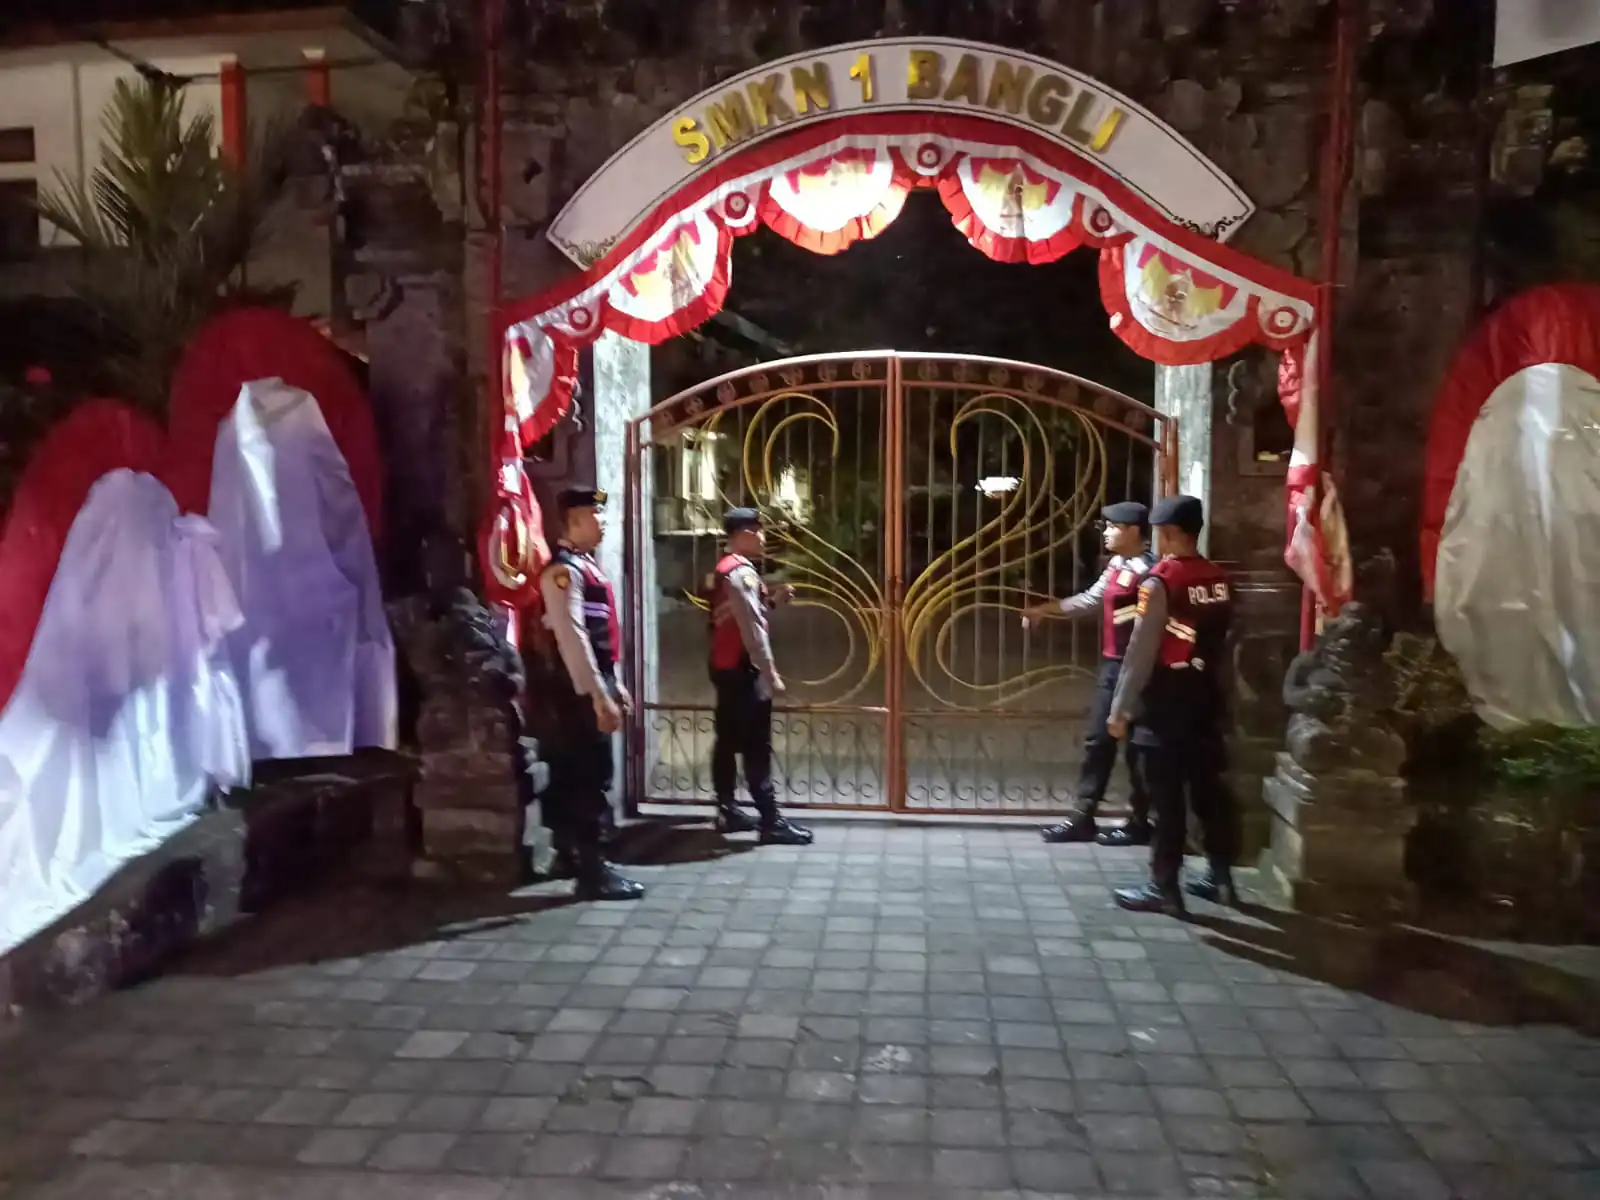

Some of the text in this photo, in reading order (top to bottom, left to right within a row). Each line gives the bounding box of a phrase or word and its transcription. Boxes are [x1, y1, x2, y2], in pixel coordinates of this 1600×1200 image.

[672, 50, 1124, 164] SMKN 1 BANGLI
